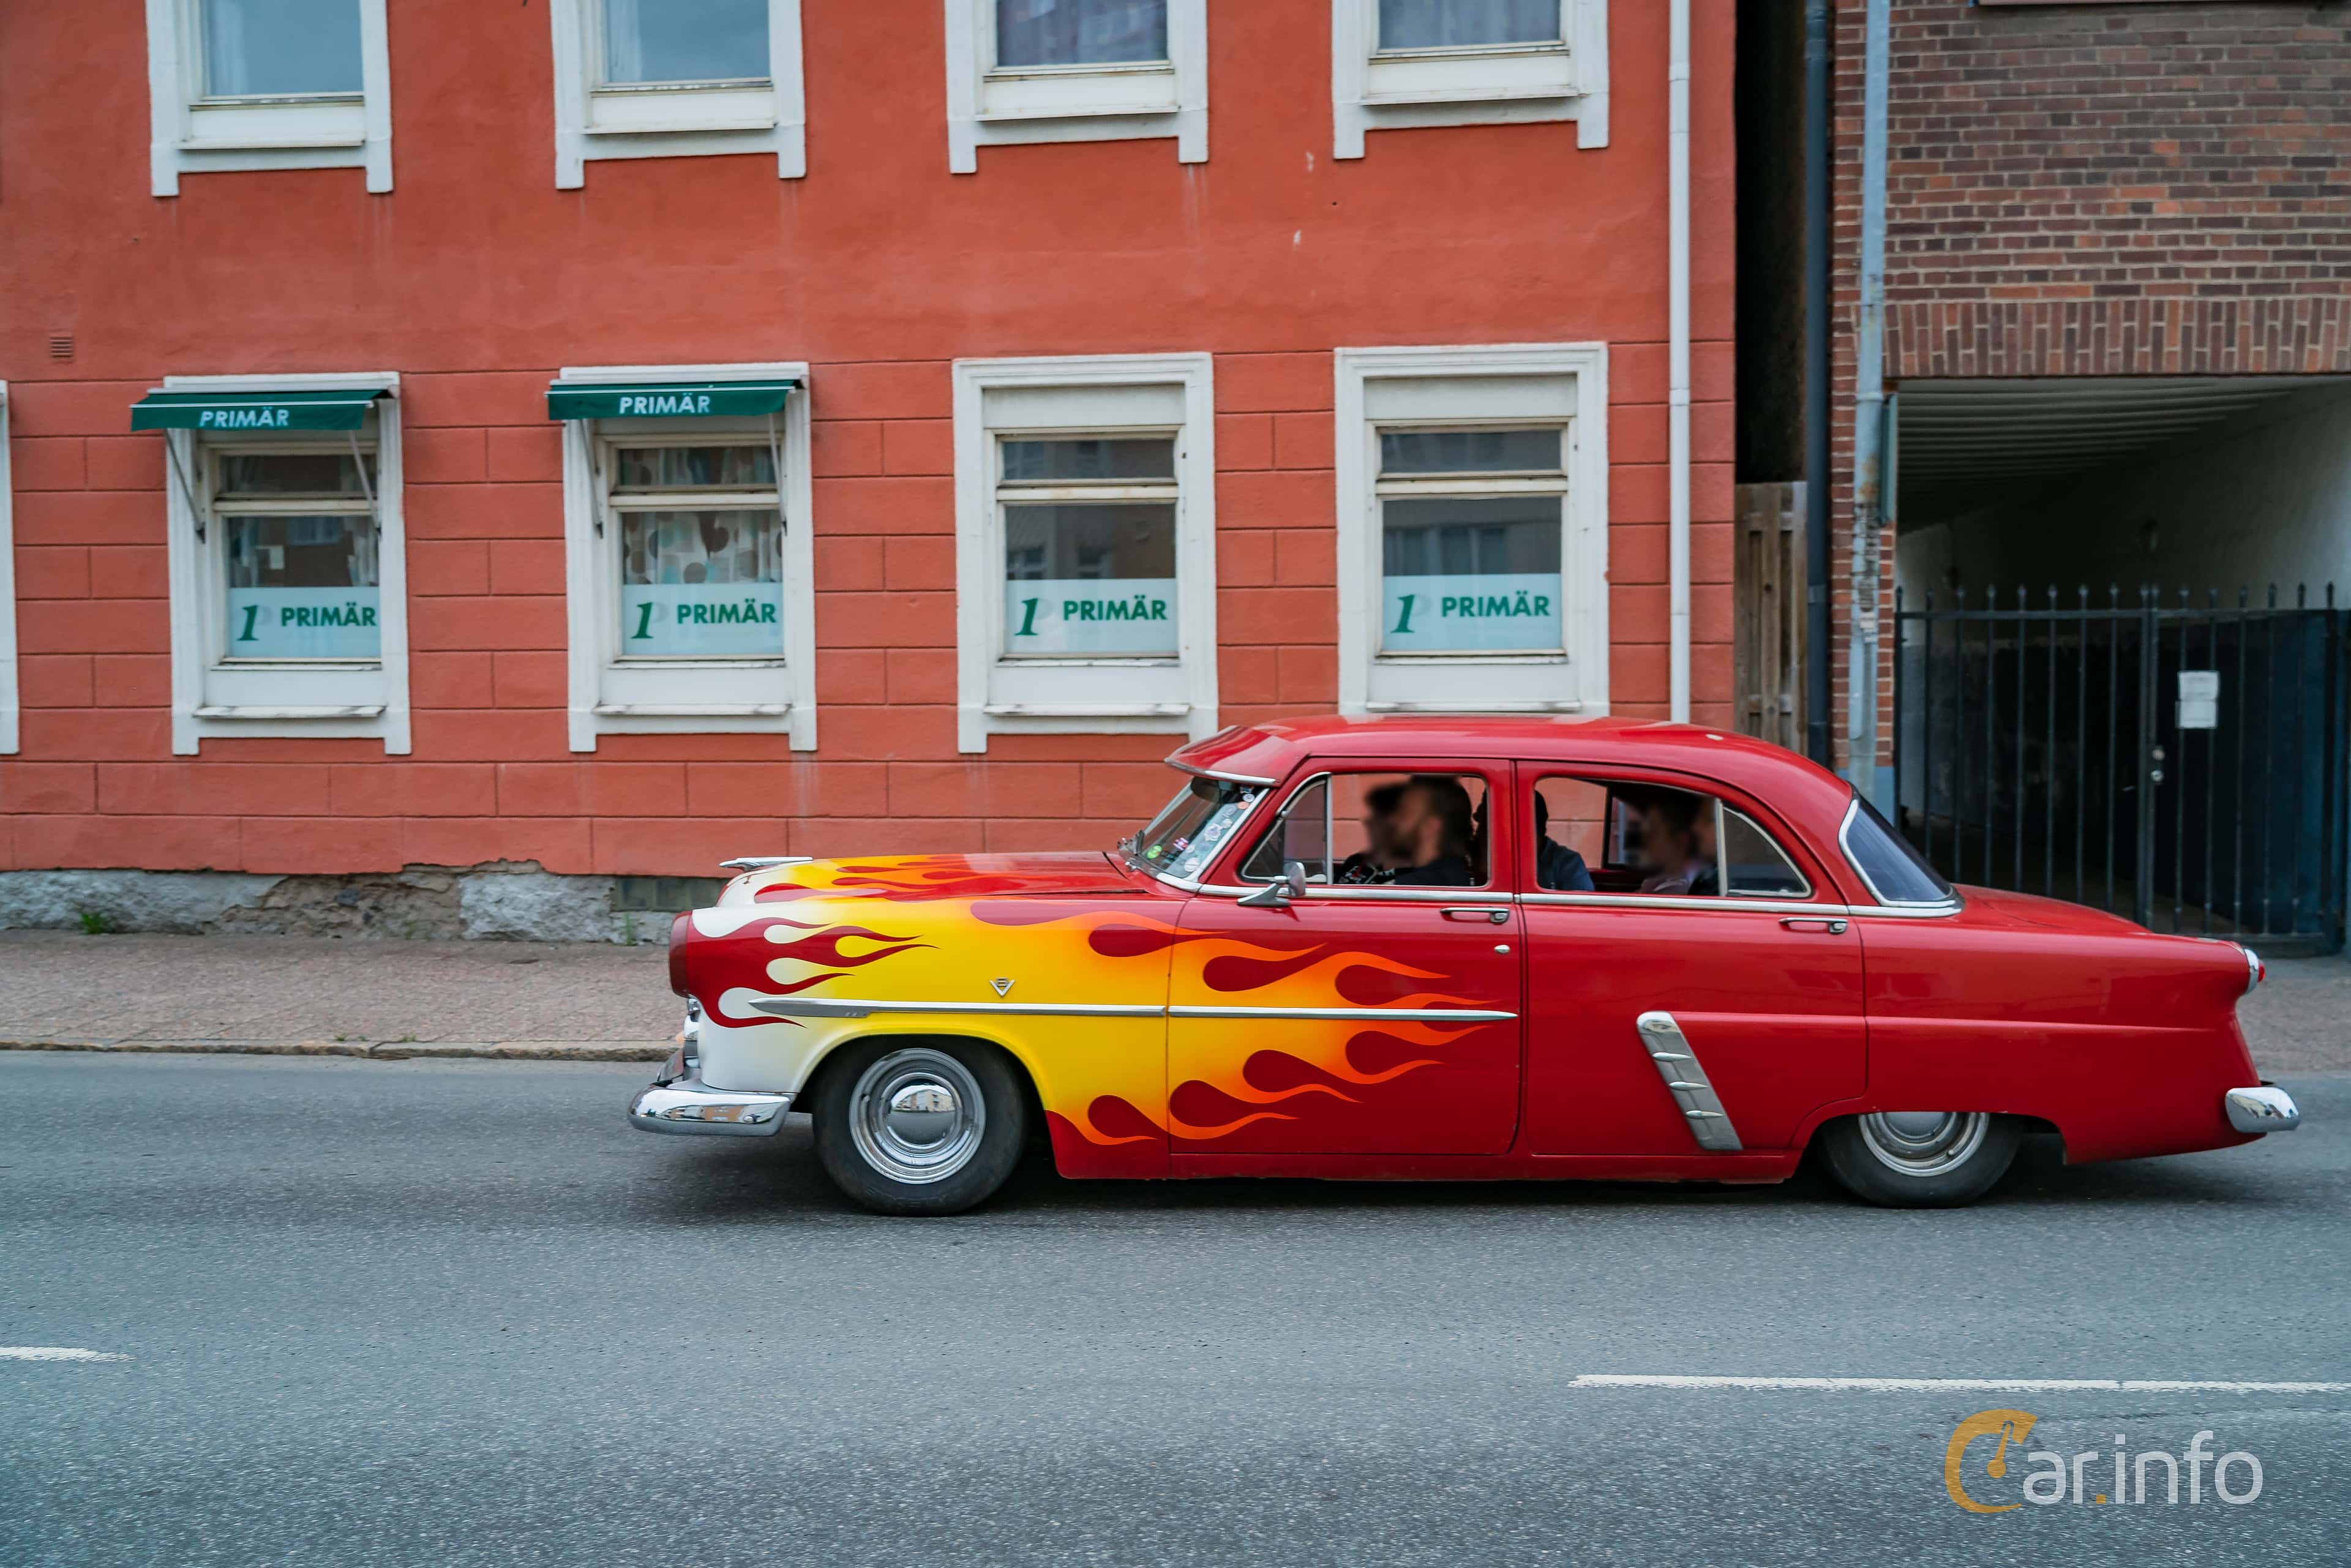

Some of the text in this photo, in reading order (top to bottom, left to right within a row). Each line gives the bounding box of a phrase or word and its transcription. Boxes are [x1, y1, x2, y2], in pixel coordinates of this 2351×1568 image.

[199, 406, 289, 427] PRIMÄR
[619, 393, 711, 415] PRIMÄR
[280, 602, 377, 627] PRIMÄR
[677, 598, 776, 625] PRIMÄR
[1063, 595, 1168, 621] PRIMÄR
[1441, 590, 1550, 617] PRIMÄR
